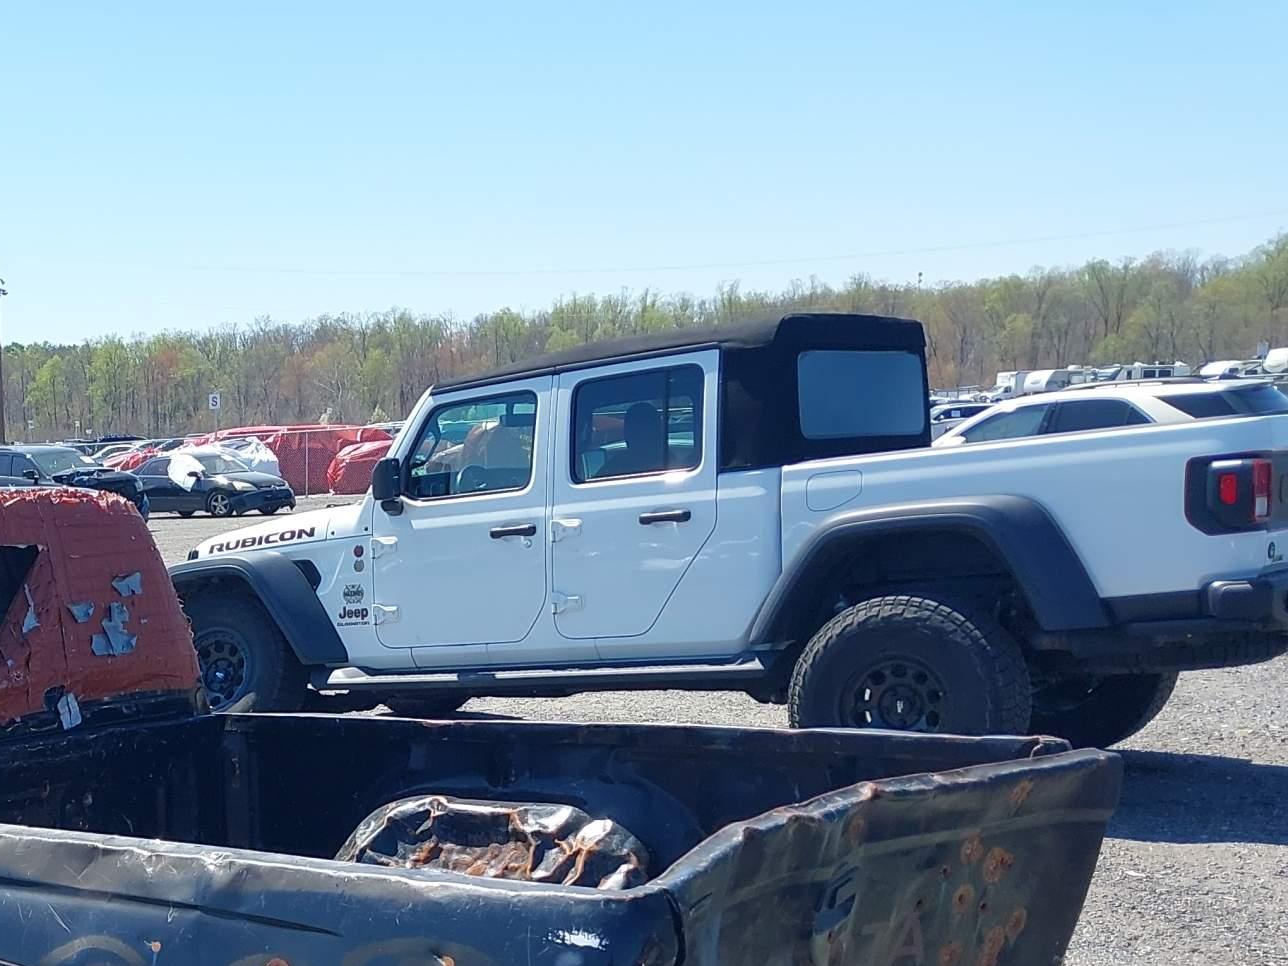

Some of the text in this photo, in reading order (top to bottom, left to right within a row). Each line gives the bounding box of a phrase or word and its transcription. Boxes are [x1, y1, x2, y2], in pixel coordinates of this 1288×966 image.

[211, 396, 218, 407] S
[209, 527, 316, 555] RUBICON
[338, 606, 369, 621] Jeep
